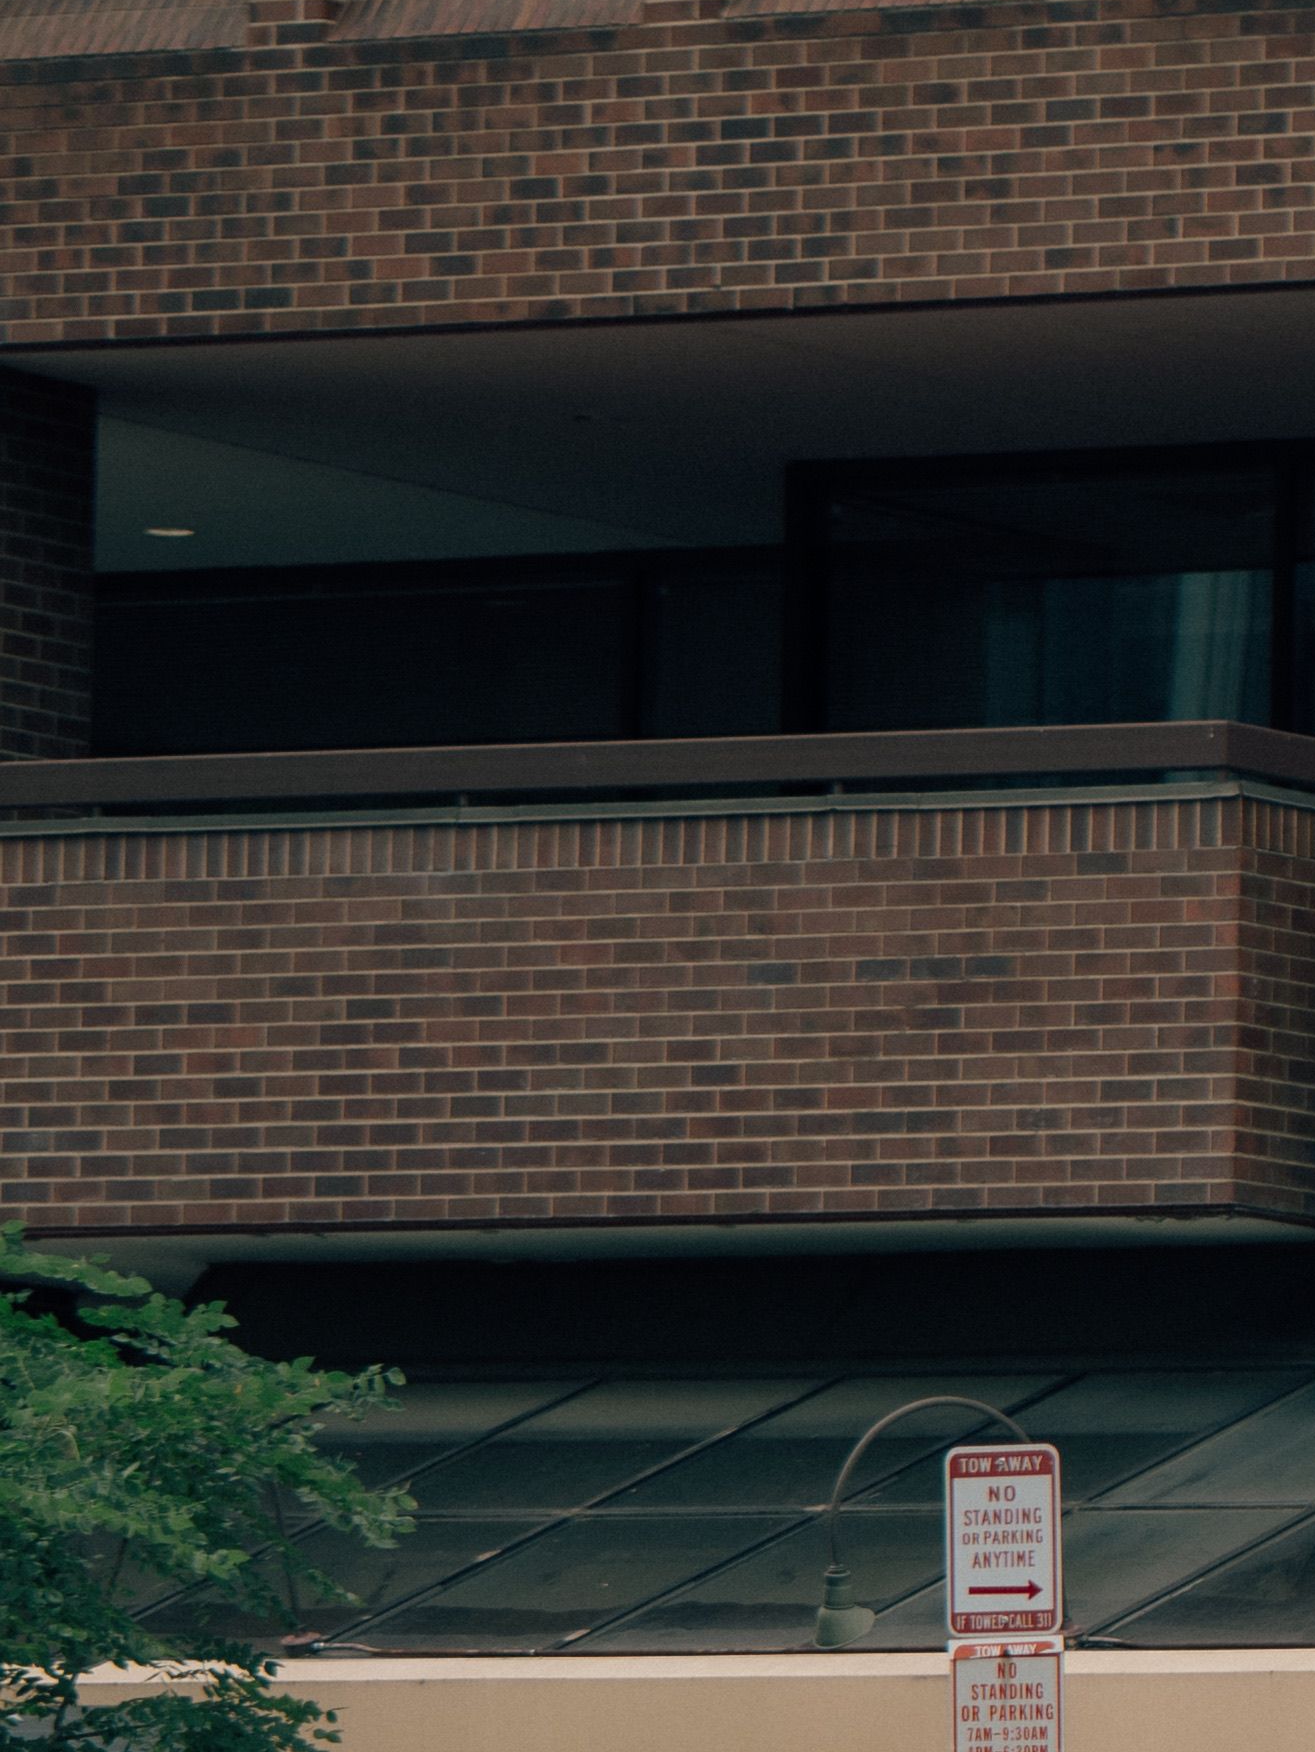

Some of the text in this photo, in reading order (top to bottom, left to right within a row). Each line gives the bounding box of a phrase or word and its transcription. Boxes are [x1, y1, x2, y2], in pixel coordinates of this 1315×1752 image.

[959, 1455, 1043, 1473] TOW AWAY
[987, 1485, 1016, 1502] NO
[963, 1508, 1042, 1526] STANDING
[962, 1529, 1043, 1545] OR PARKING
[972, 1550, 1036, 1569] ANYTIME
[956, 1612, 1052, 1630] IF TOWED CALL 311
[975, 1643, 1037, 1657] TOW AWAY
[997, 1662, 1017, 1679] NO
[971, 1682, 1044, 1701] STANDING
[961, 1703, 1054, 1722] OR PARKING
[967, 1726, 1048, 1742] 7AM-9:30AM
